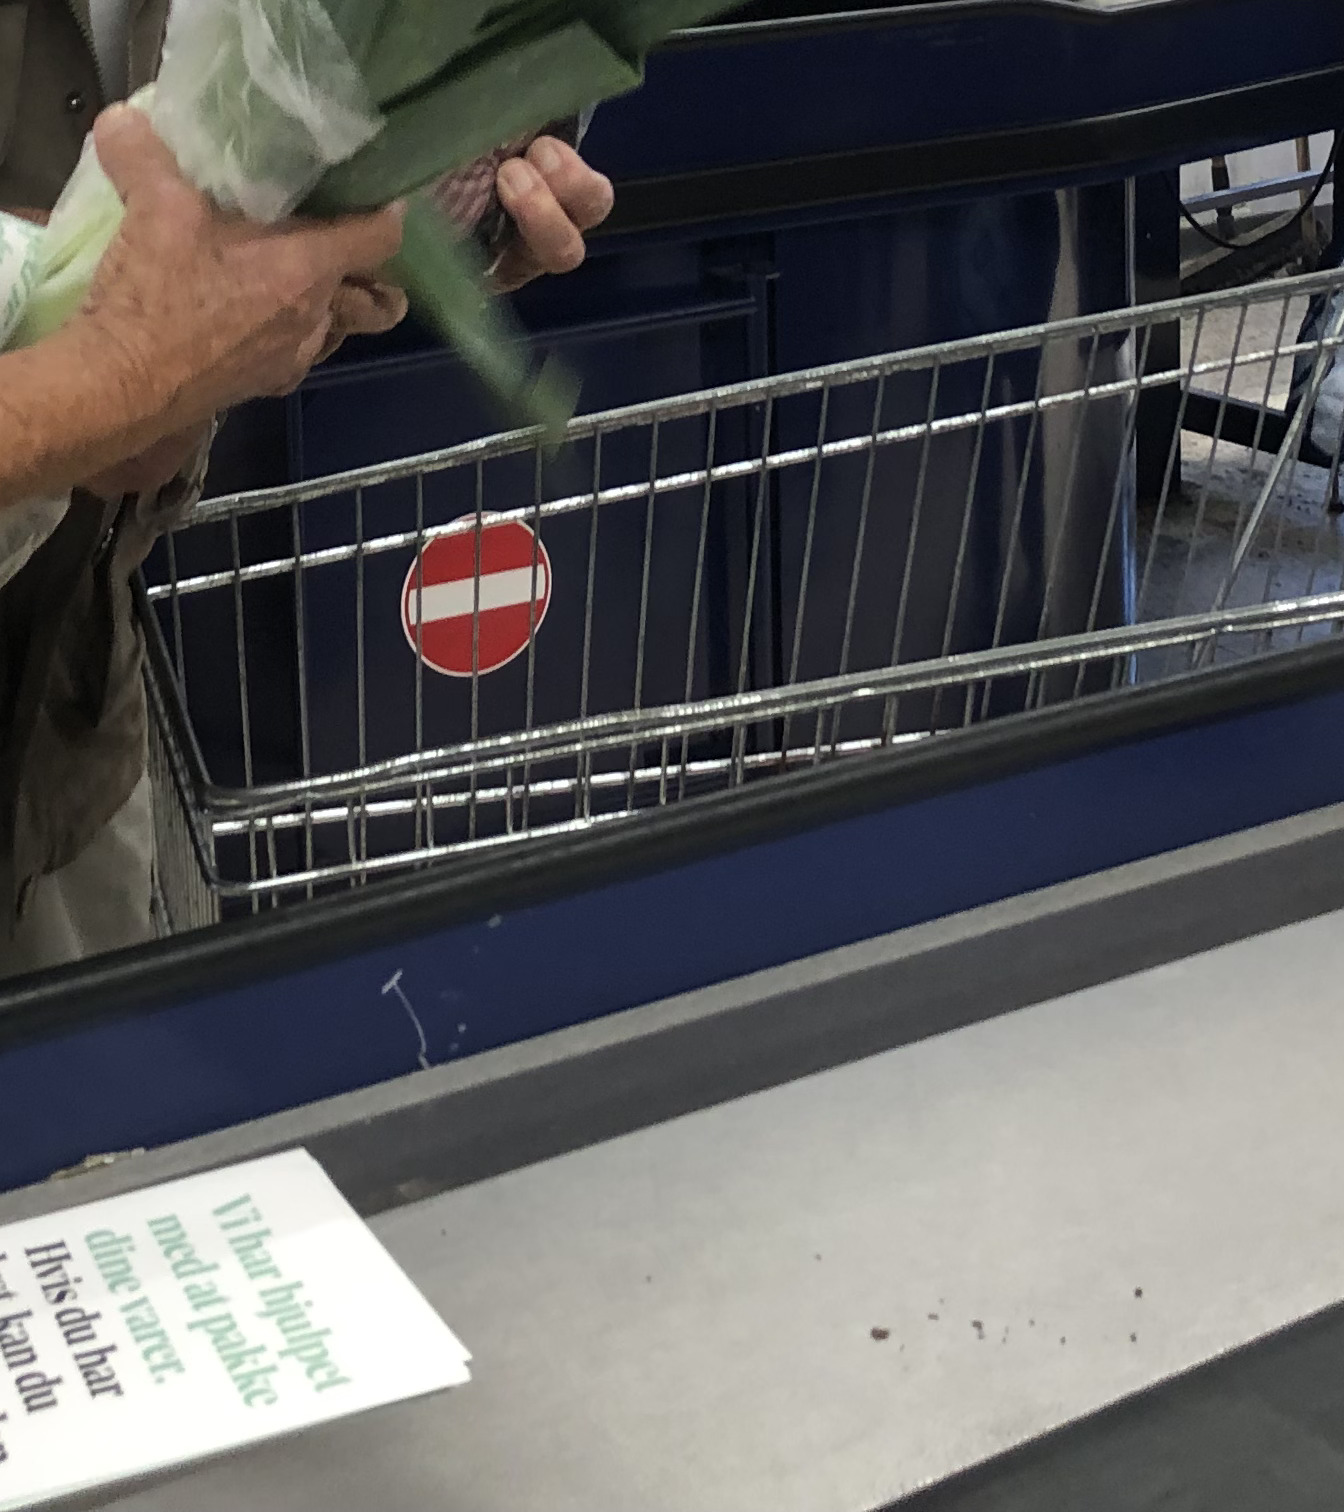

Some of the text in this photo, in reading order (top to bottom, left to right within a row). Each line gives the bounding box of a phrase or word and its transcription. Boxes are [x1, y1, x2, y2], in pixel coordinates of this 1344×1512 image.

[23, 1239, 126, 1400] Hvis du har
[84, 1228, 186, 1385] dine varer.
[146, 1213, 279, 1408] med at pakke
[212, 1192, 353, 1393] Vi har hjulpet
[15, 1371, 64, 1415] du
